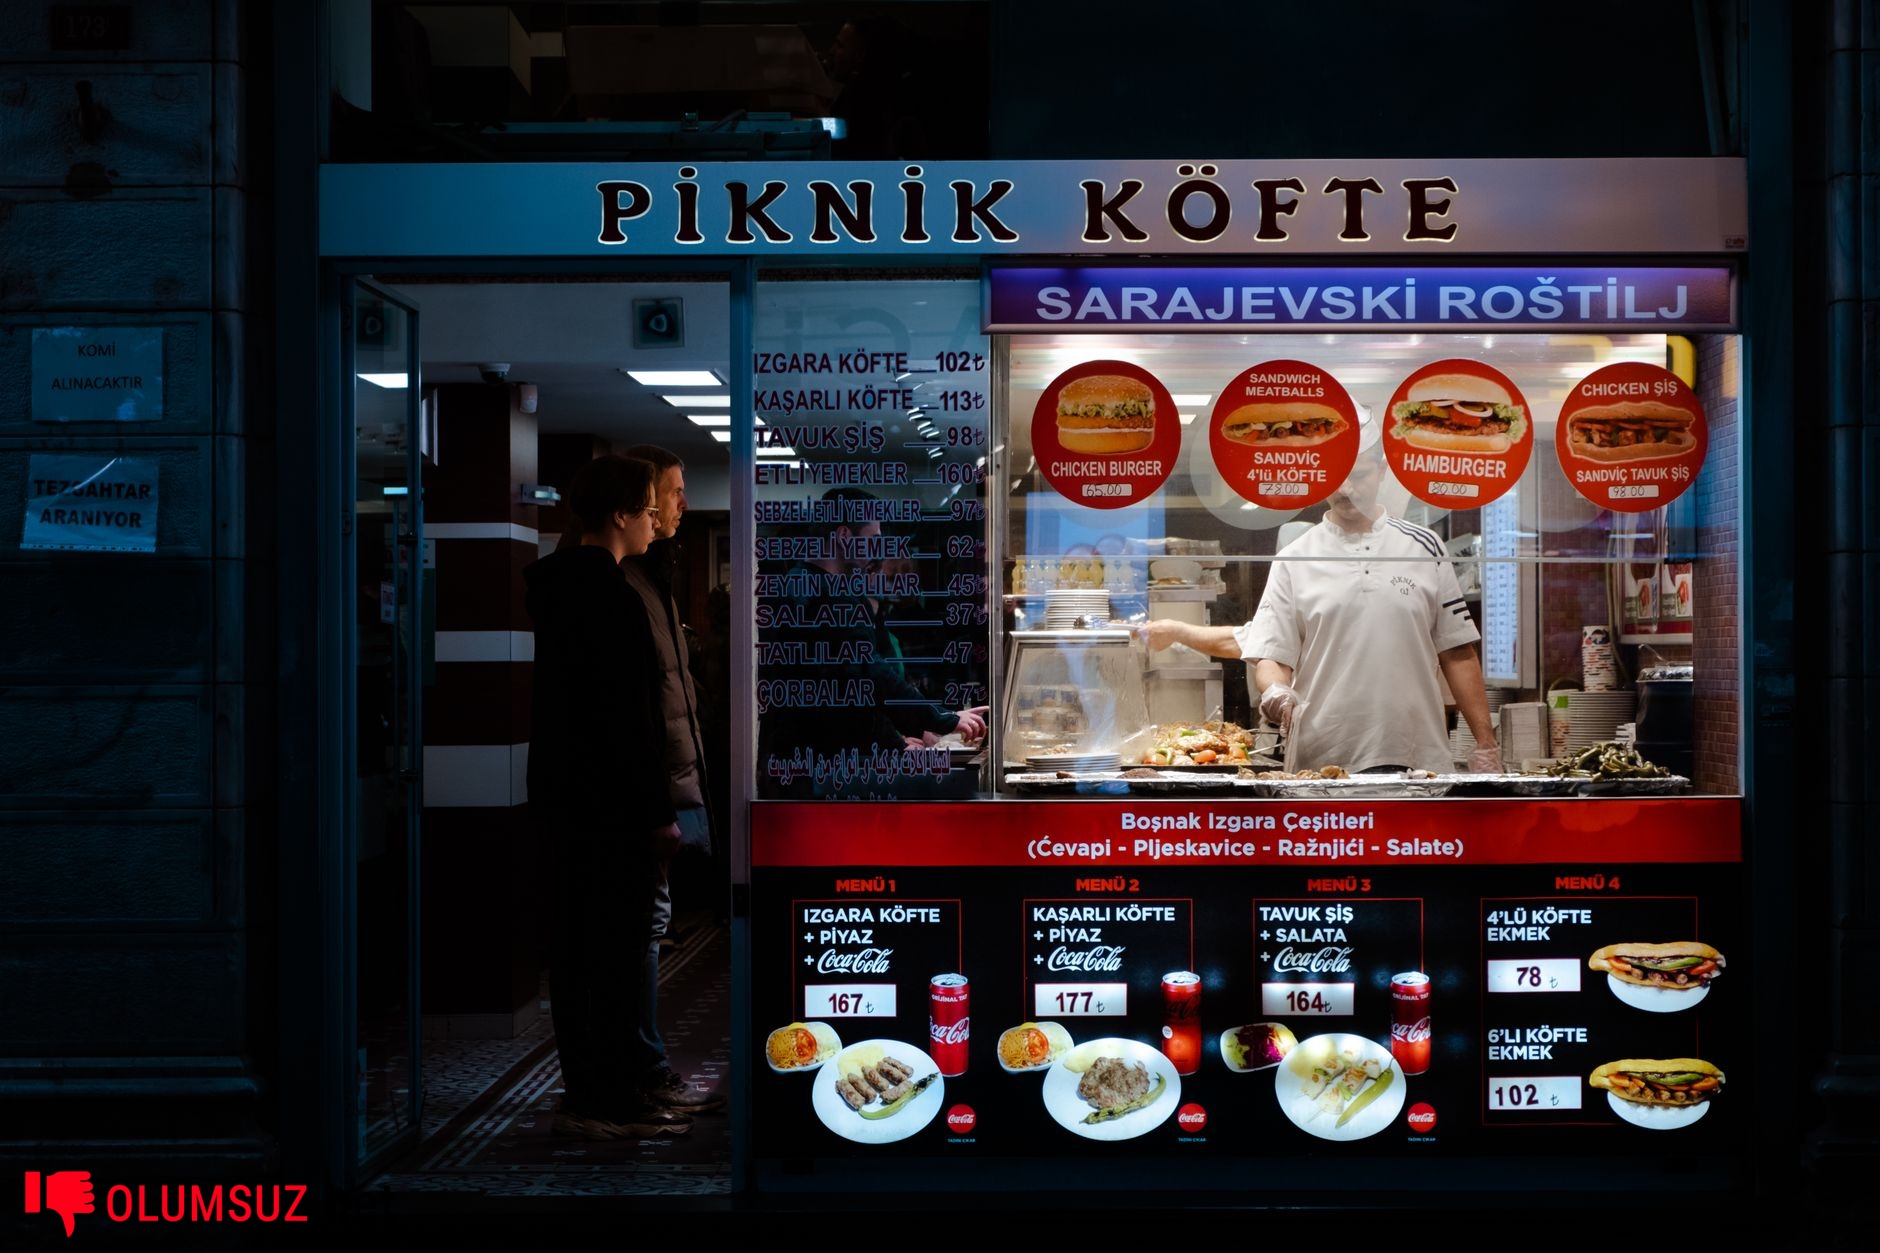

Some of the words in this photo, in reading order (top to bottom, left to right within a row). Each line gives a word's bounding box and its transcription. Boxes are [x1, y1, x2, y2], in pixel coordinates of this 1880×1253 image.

[596, 163, 1020, 245] PİKNİK
[1079, 163, 1459, 243] KÖFTE
[1035, 277, 1416, 322] SARAJEVSKİ
[1439, 276, 1688, 320] ROŠTİLJ
[78, 341, 116, 357] KOMİ
[754, 352, 832, 374] IZGARA
[839, 348, 909, 374] KÖFTE
[51, 376, 144, 391] ALINACAKTIR
[1249, 373, 1321, 386] SANDWICH
[1581, 382, 1650, 397] CHICKEN
[1653, 378, 1679, 398] ŞİŞ
[754, 389, 841, 416] KAŞARLI
[848, 385, 914, 411] KÖFTE
[1245, 386, 1324, 398] MEATBALLS
[754, 426, 839, 448] TAVUK
[844, 421, 885, 452] ŞİŞ
[1051, 461, 1107, 478] CHICKEN
[1109, 459, 1162, 477] BURGER
[1254, 450, 1321, 468] SANDVİÇ
[1403, 452, 1507, 479] HAMBURGER
[754, 458, 805, 485] ETLİ
[809, 463, 908, 485] YEMEKLER
[1277, 467, 1327, 482] KÖFTE
[1576, 466, 1628, 483] SANDVİÇ
[1631, 467, 1668, 481] TAVUK
[1671, 464, 1690, 482] ŞİŞ
[33, 479, 151, 499] TEZGAHTAR
[40, 508, 141, 528] ARANIYOR
[754, 496, 812, 523] SEBZELİ
[813, 494, 843, 523] ETLİ
[844, 499, 922, 523] YEMEKLER
[754, 532, 837, 560] SEBZELİ
[841, 536, 912, 560] YEMEK
[754, 568, 821, 597] ZEYTİN
[824, 568, 920, 597] YAĞLILAR
[754, 604, 873, 628] SALATA
[754, 641, 874, 665] TATLILAR
[757, 679, 876, 714] ÇORBALAR
[1121, 811, 1201, 834] Boşnak
[1208, 811, 1276, 834] Izgara
[1282, 811, 1375, 834] Çeşitleri
[1027, 836, 1112, 860] (Ćevapi
[1134, 838, 1255, 860] Pljeskavice
[1278, 837, 1365, 860] Ražnjići
[1386, 837, 1464, 860] Salate)
[836, 876, 886, 893] MENÜ
[888, 879, 896, 892] 1
[1076, 876, 1125, 892] MENÜ
[1128, 879, 1140, 892] 2
[1307, 876, 1358, 892] MENÜ
[1360, 879, 1372, 892] 3
[1555, 874, 1605, 890] MENÜ
[1608, 877, 1621, 890] 4
[804, 908, 875, 924] IZGARA
[880, 904, 941, 924] KÖFTE
[1033, 906, 1111, 925] KAŞARLI
[1115, 904, 1176, 922] KÖFTE
[1259, 907, 1321, 922] TAVUK
[1325, 903, 1354, 924] ŞİŞ
[1532, 907, 1592, 925] KÖFTE
[820, 927, 873, 945] PİYAZ
[1049, 925, 1102, 943] PİYAZ
[1276, 928, 1347, 943] SALATA
[1487, 927, 1551, 942] EKMEK
[1526, 1025, 1588, 1043] KÖFTE
[1488, 1045, 1553, 1061] EKMEK
